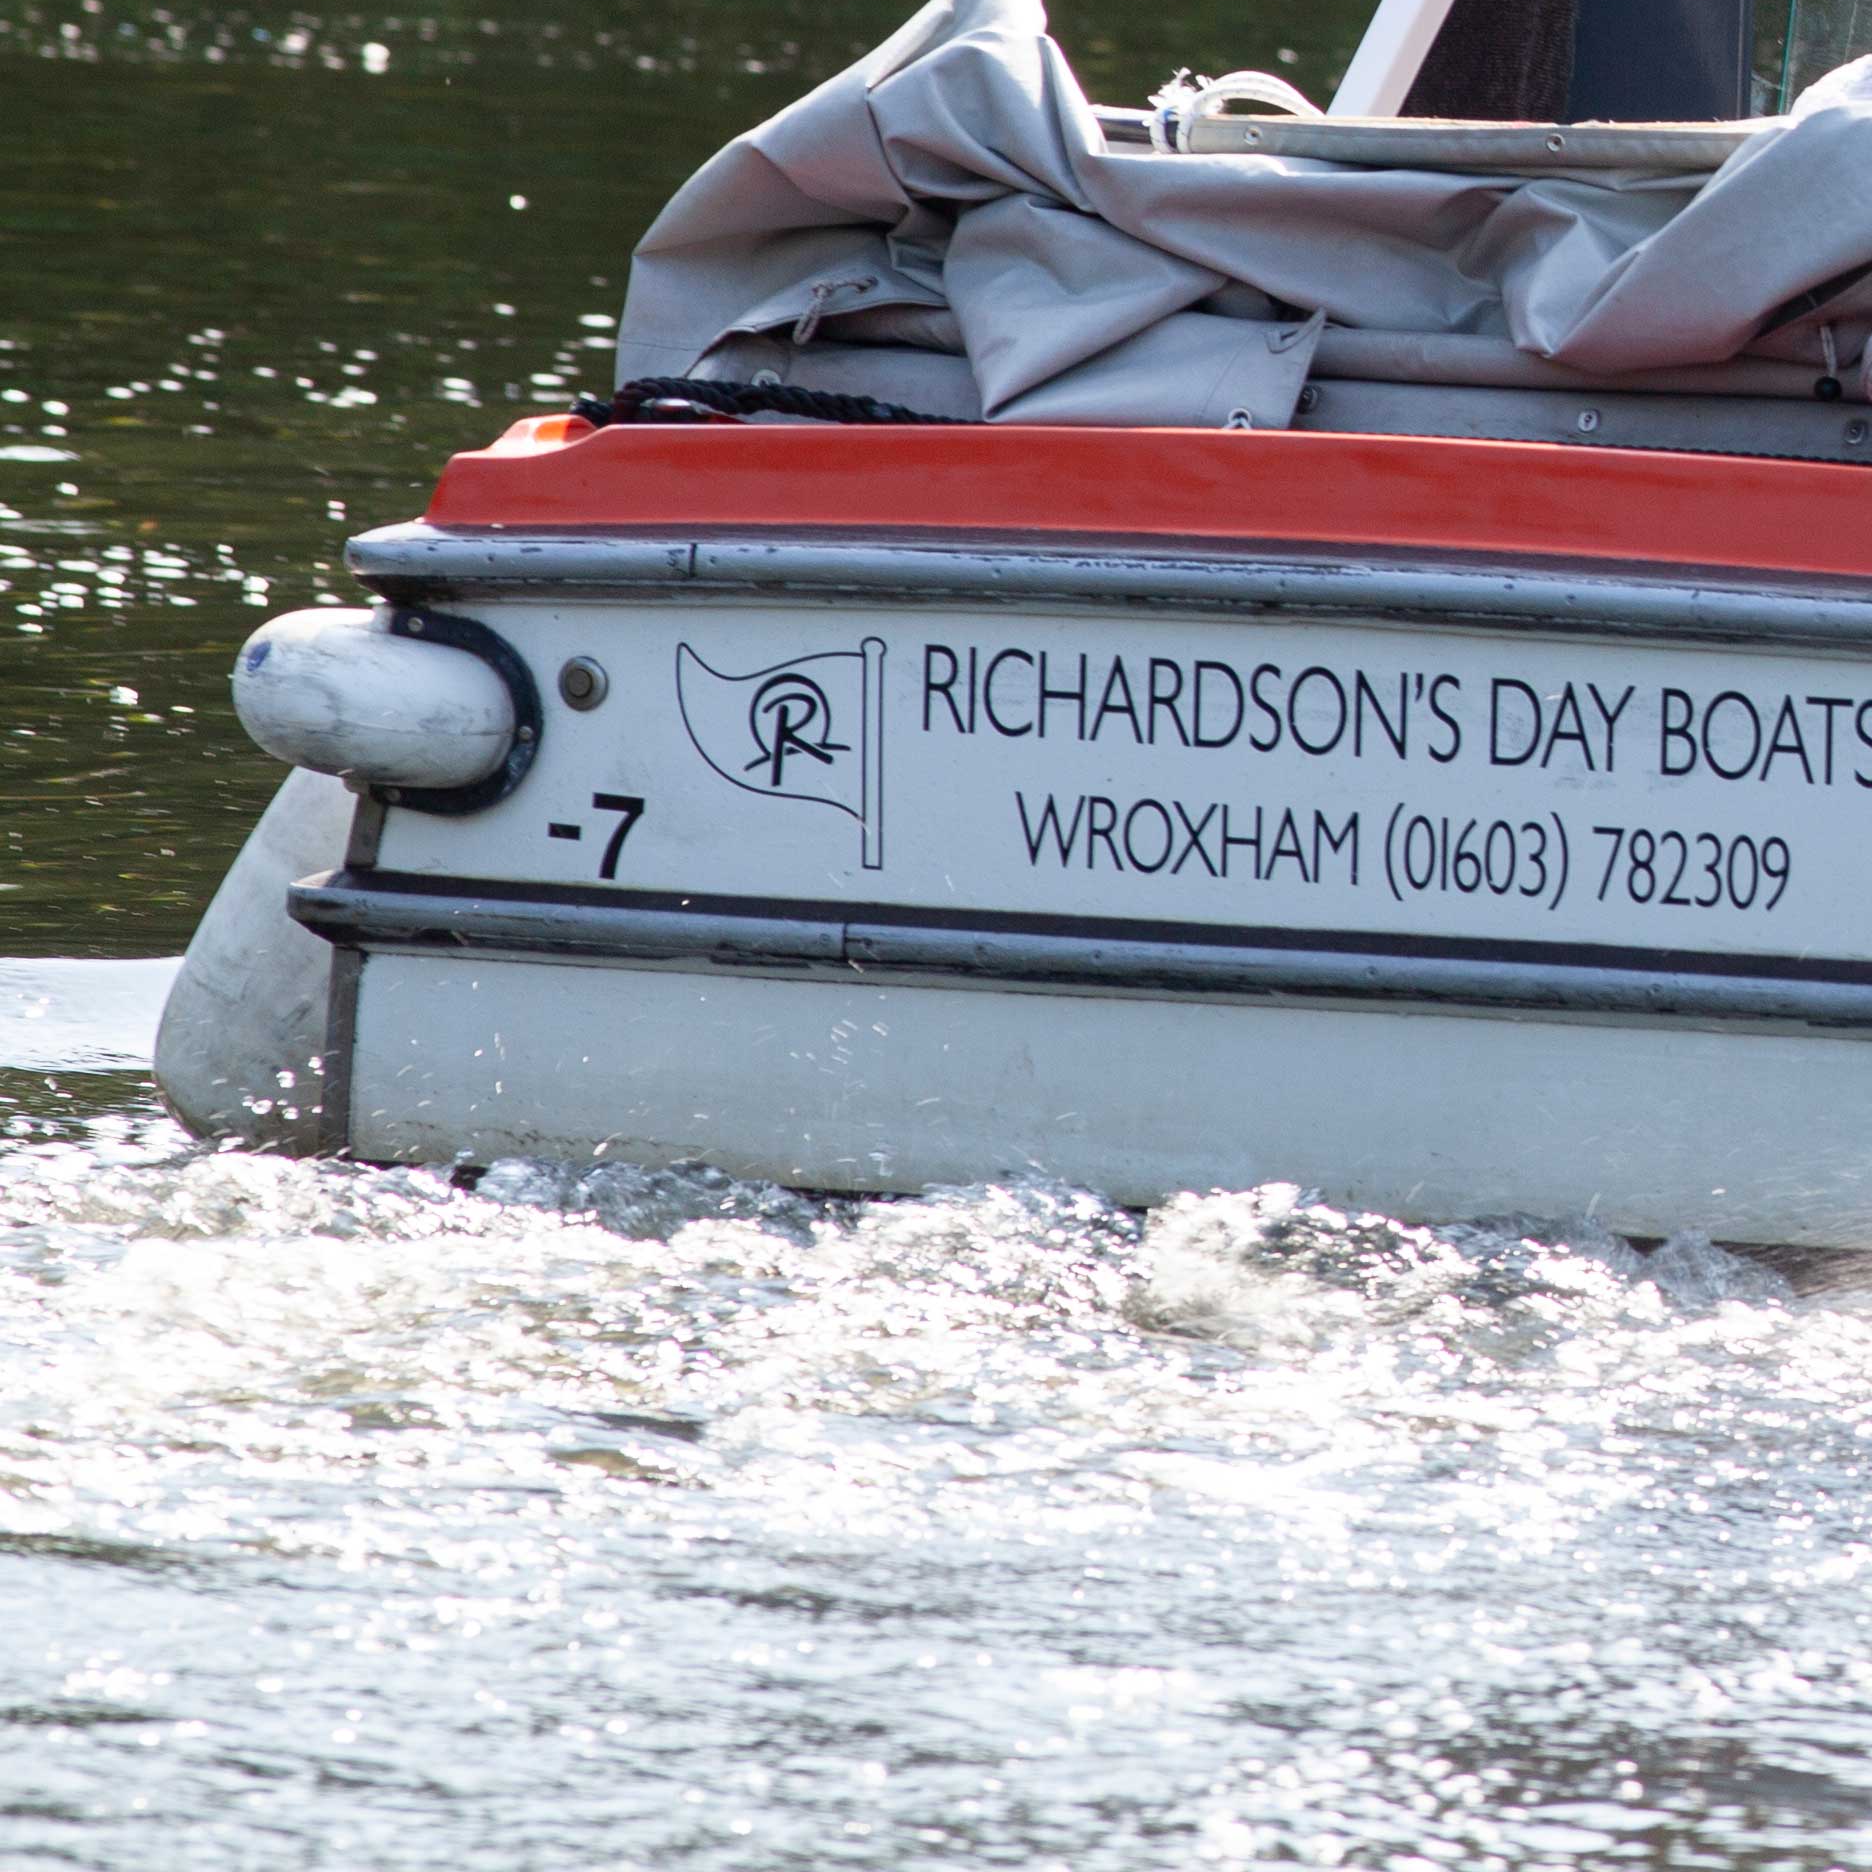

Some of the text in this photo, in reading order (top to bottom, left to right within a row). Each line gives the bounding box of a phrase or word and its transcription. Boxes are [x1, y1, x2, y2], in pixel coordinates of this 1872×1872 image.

[922, 643, 1463, 764] RICHARDSON'S
[1489, 677, 1636, 773] DAY
[1014, 790, 1791, 912] WROXHAM (01603) 782309
